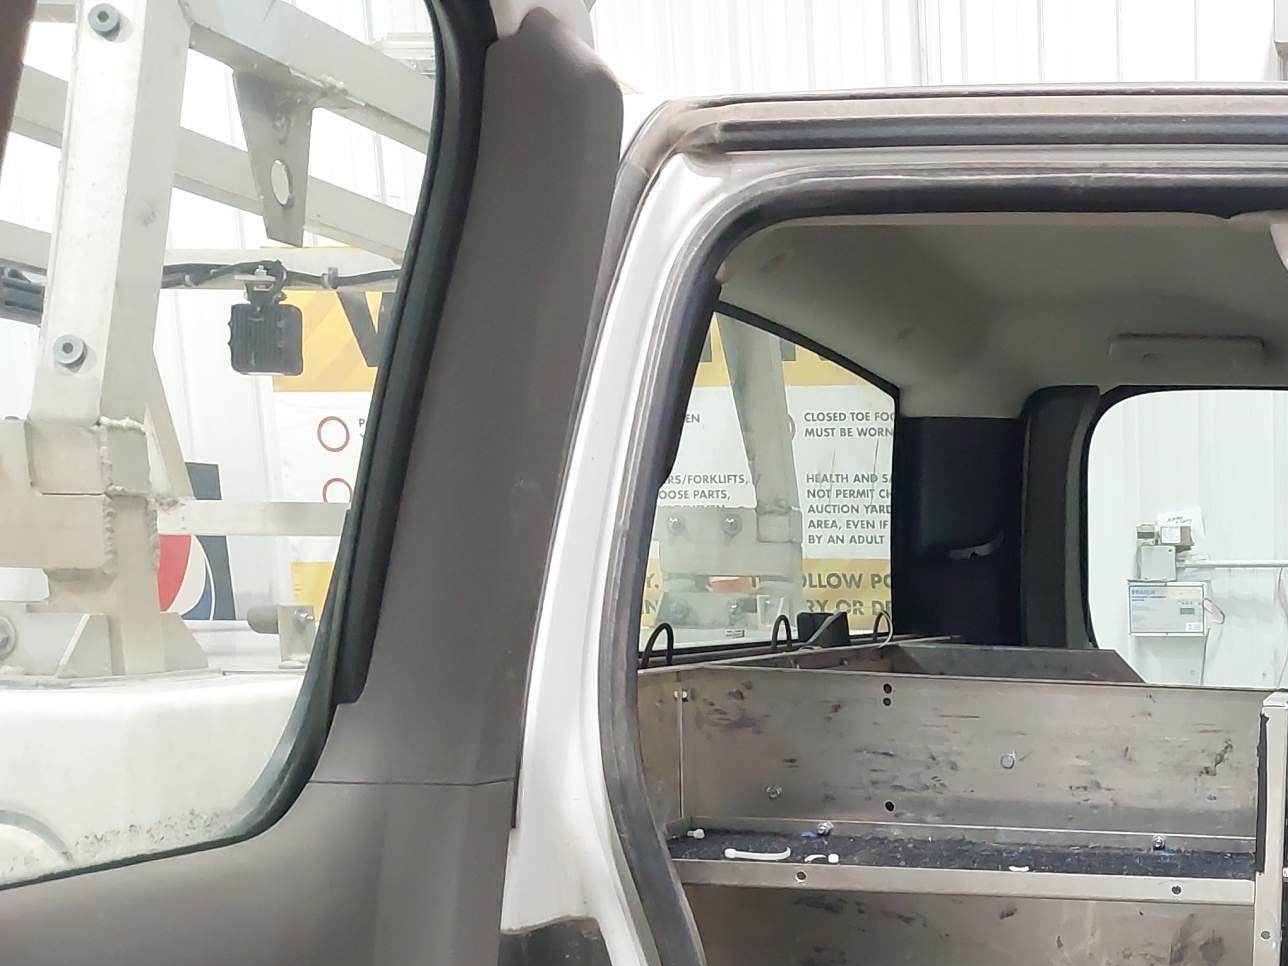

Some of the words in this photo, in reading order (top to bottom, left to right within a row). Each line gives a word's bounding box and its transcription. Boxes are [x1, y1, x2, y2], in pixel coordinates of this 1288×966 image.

[803, 411, 847, 422] CLOSED
[849, 411, 871, 422] TOE
[804, 427, 836, 438] MUST
[839, 427, 853, 438] BE
[806, 473, 849, 484] HEALTH
[852, 473, 878, 484] AND
[658, 489, 689, 500] OOSE
[693, 489, 731, 500] PARTS,
[807, 489, 831, 499] NOT
[835, 489, 875, 499] PERMIT
[807, 504, 860, 514] AUCTION
[807, 519, 842, 530] AREA,
[846, 519, 876, 529] EVEN
[879, 519, 889, 529] IF
[808, 534, 823, 544] BY
[827, 534, 845, 544] AN
[849, 534, 885, 544] ADULT
